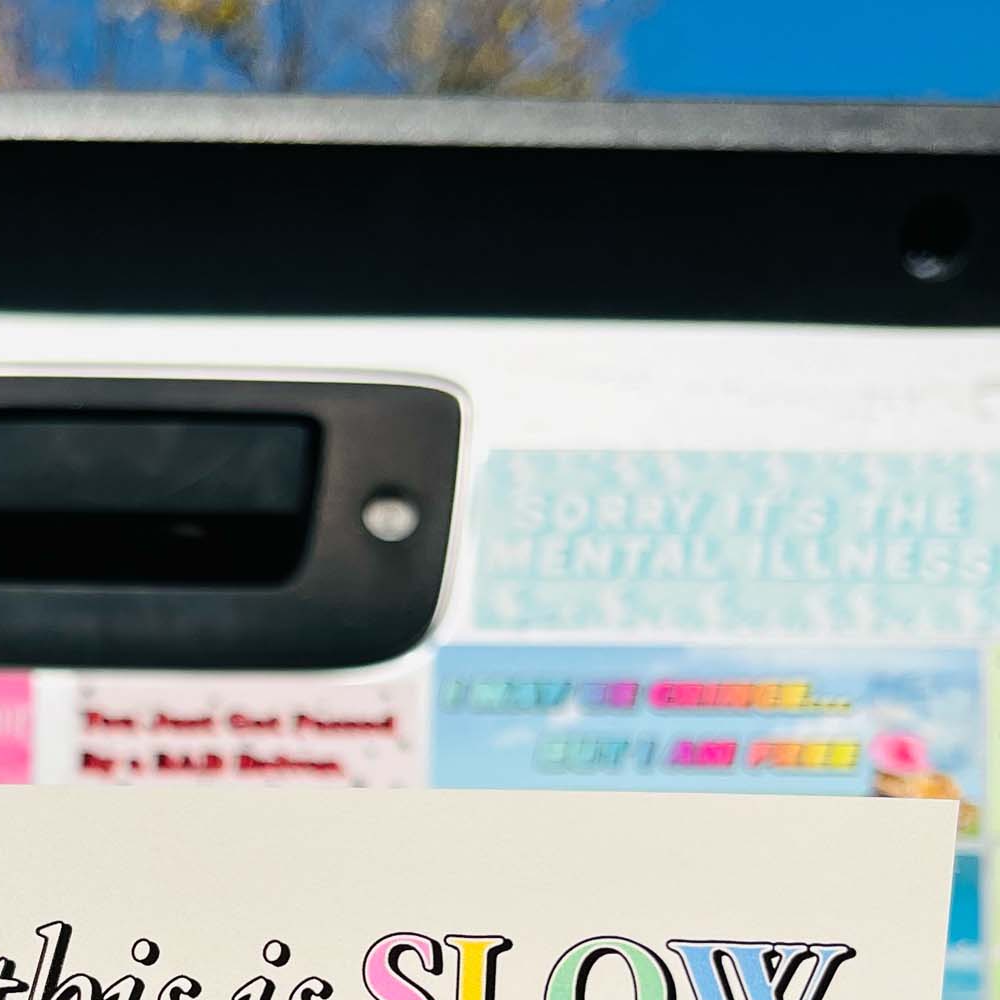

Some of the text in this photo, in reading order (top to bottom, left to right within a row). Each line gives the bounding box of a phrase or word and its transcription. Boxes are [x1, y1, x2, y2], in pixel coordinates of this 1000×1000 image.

[512, 491, 974, 539] SORRY IT'S THE
[490, 535, 994, 584] MENTAL ILLNESS
